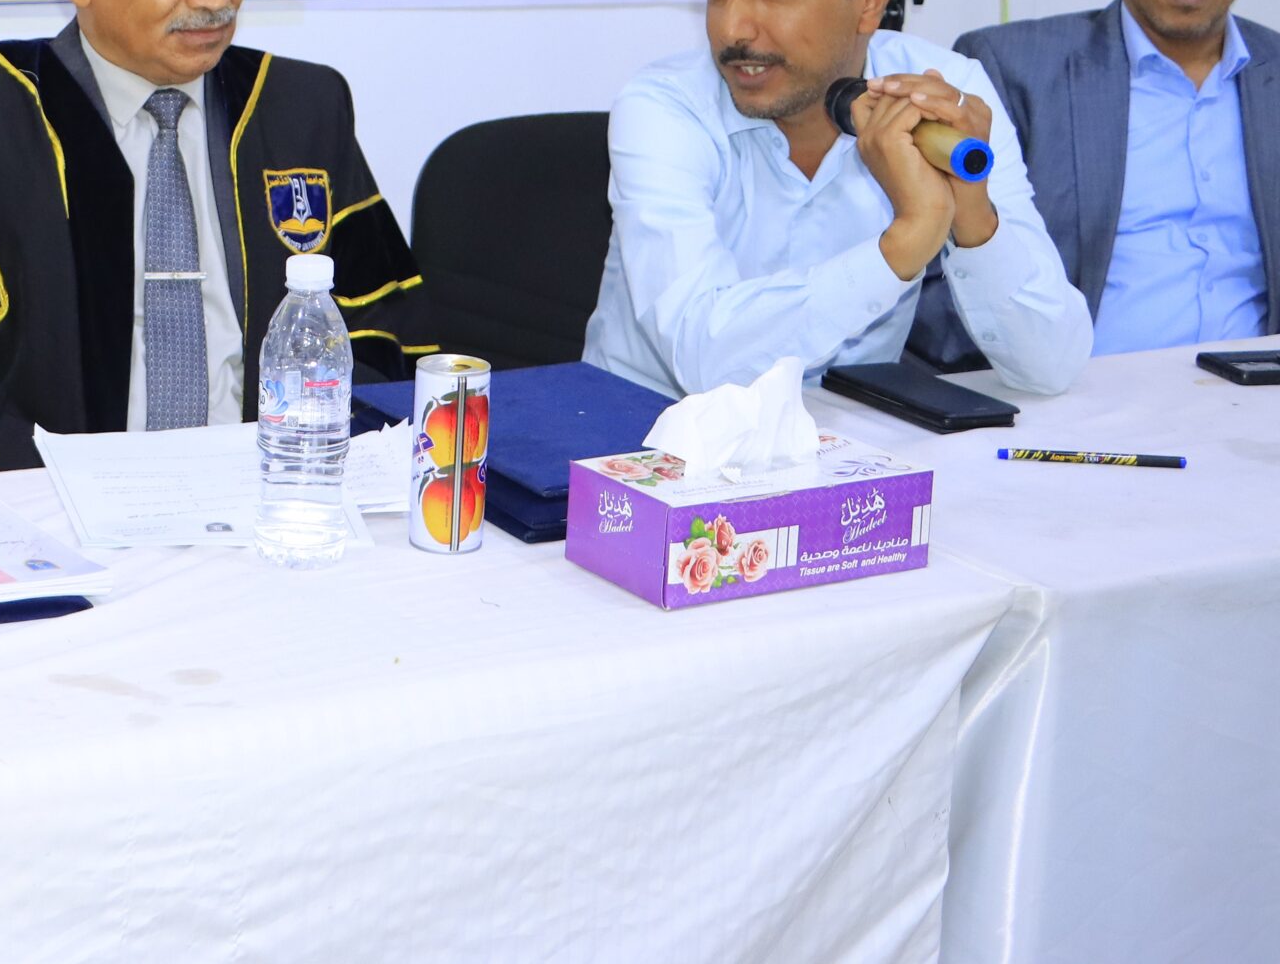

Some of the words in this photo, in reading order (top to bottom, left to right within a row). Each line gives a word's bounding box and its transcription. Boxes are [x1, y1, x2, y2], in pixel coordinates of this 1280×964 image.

[800, 566, 826, 576] Tissue
[827, 564, 840, 572] are
[841, 559, 858, 570] Soft
[861, 557, 876, 567] and
[877, 552, 908, 564] Healthy
